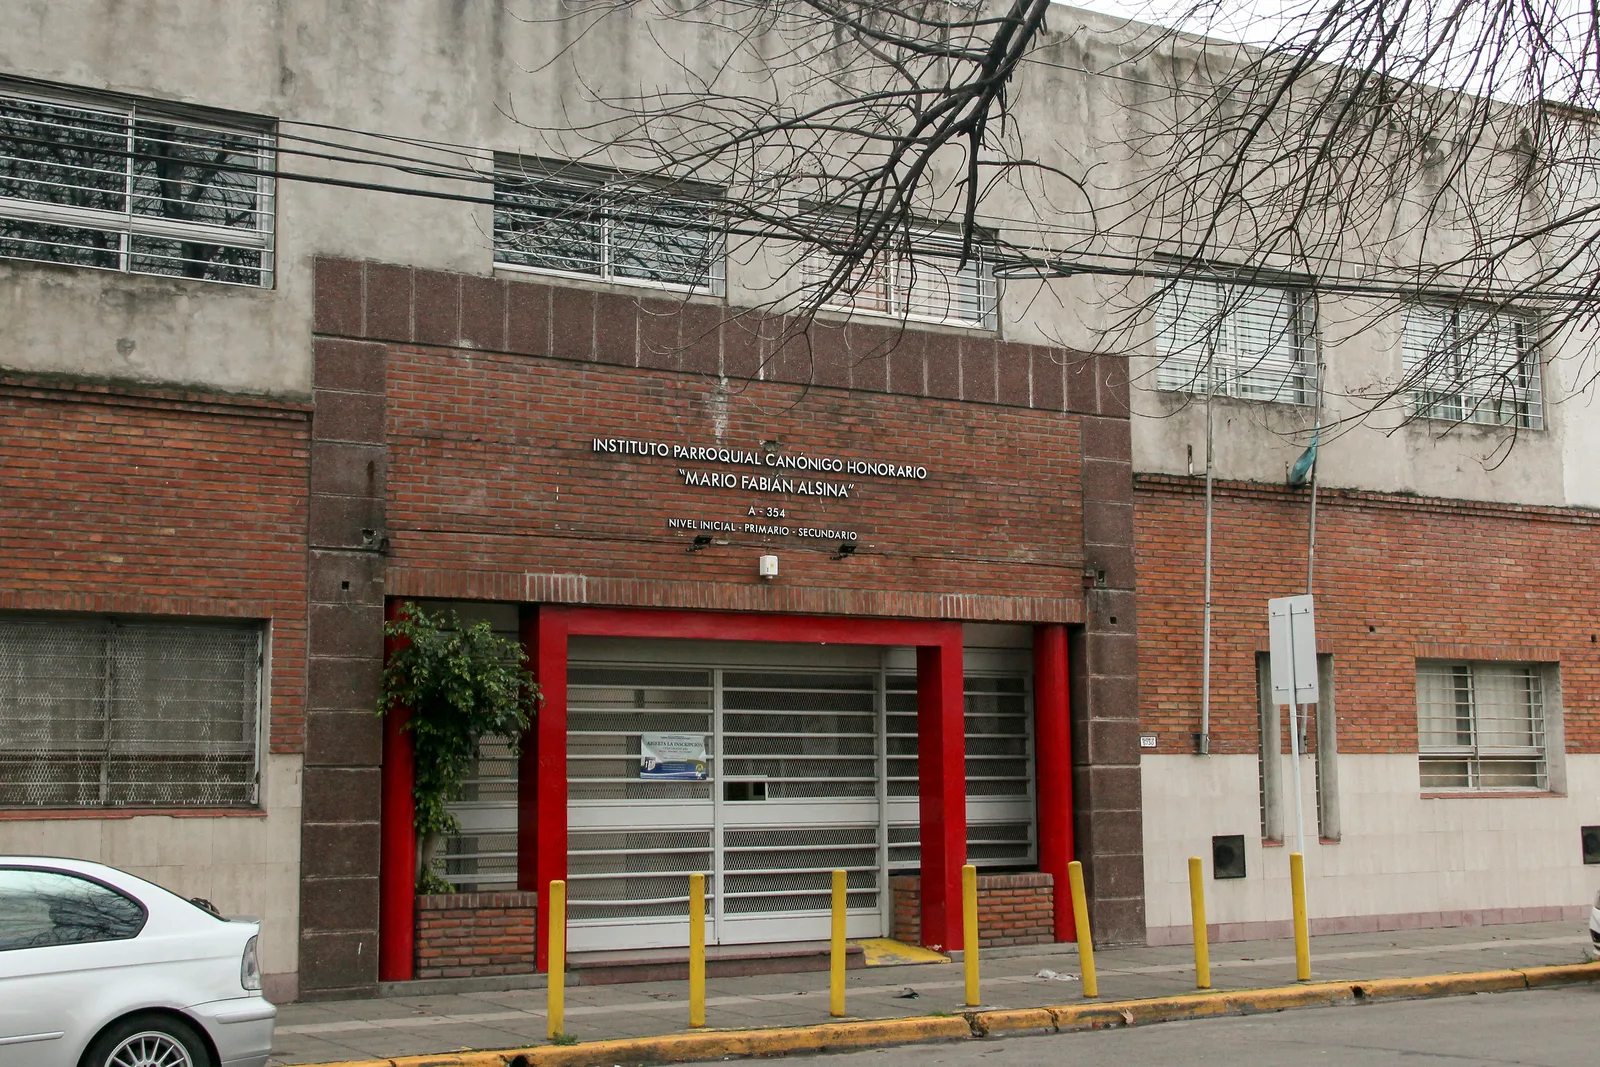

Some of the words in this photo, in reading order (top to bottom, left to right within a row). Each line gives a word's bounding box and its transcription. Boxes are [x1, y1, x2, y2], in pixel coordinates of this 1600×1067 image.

[593, 438, 669, 457] INSTITUTO
[673, 444, 762, 465] PARROQUIAL
[765, 452, 843, 473] CANÓNIGO
[846, 460, 927, 480] HONORARIO
[741, 474, 794, 494] FABIÁN
[747, 506, 756, 516] A
[766, 507, 786, 518] 354
[668, 518, 698, 529] NIVEL
[699, 520, 736, 532] INICIAL
[744, 523, 790, 537] PRIMARIO
[798, 527, 858, 541] SECUNDARIO
